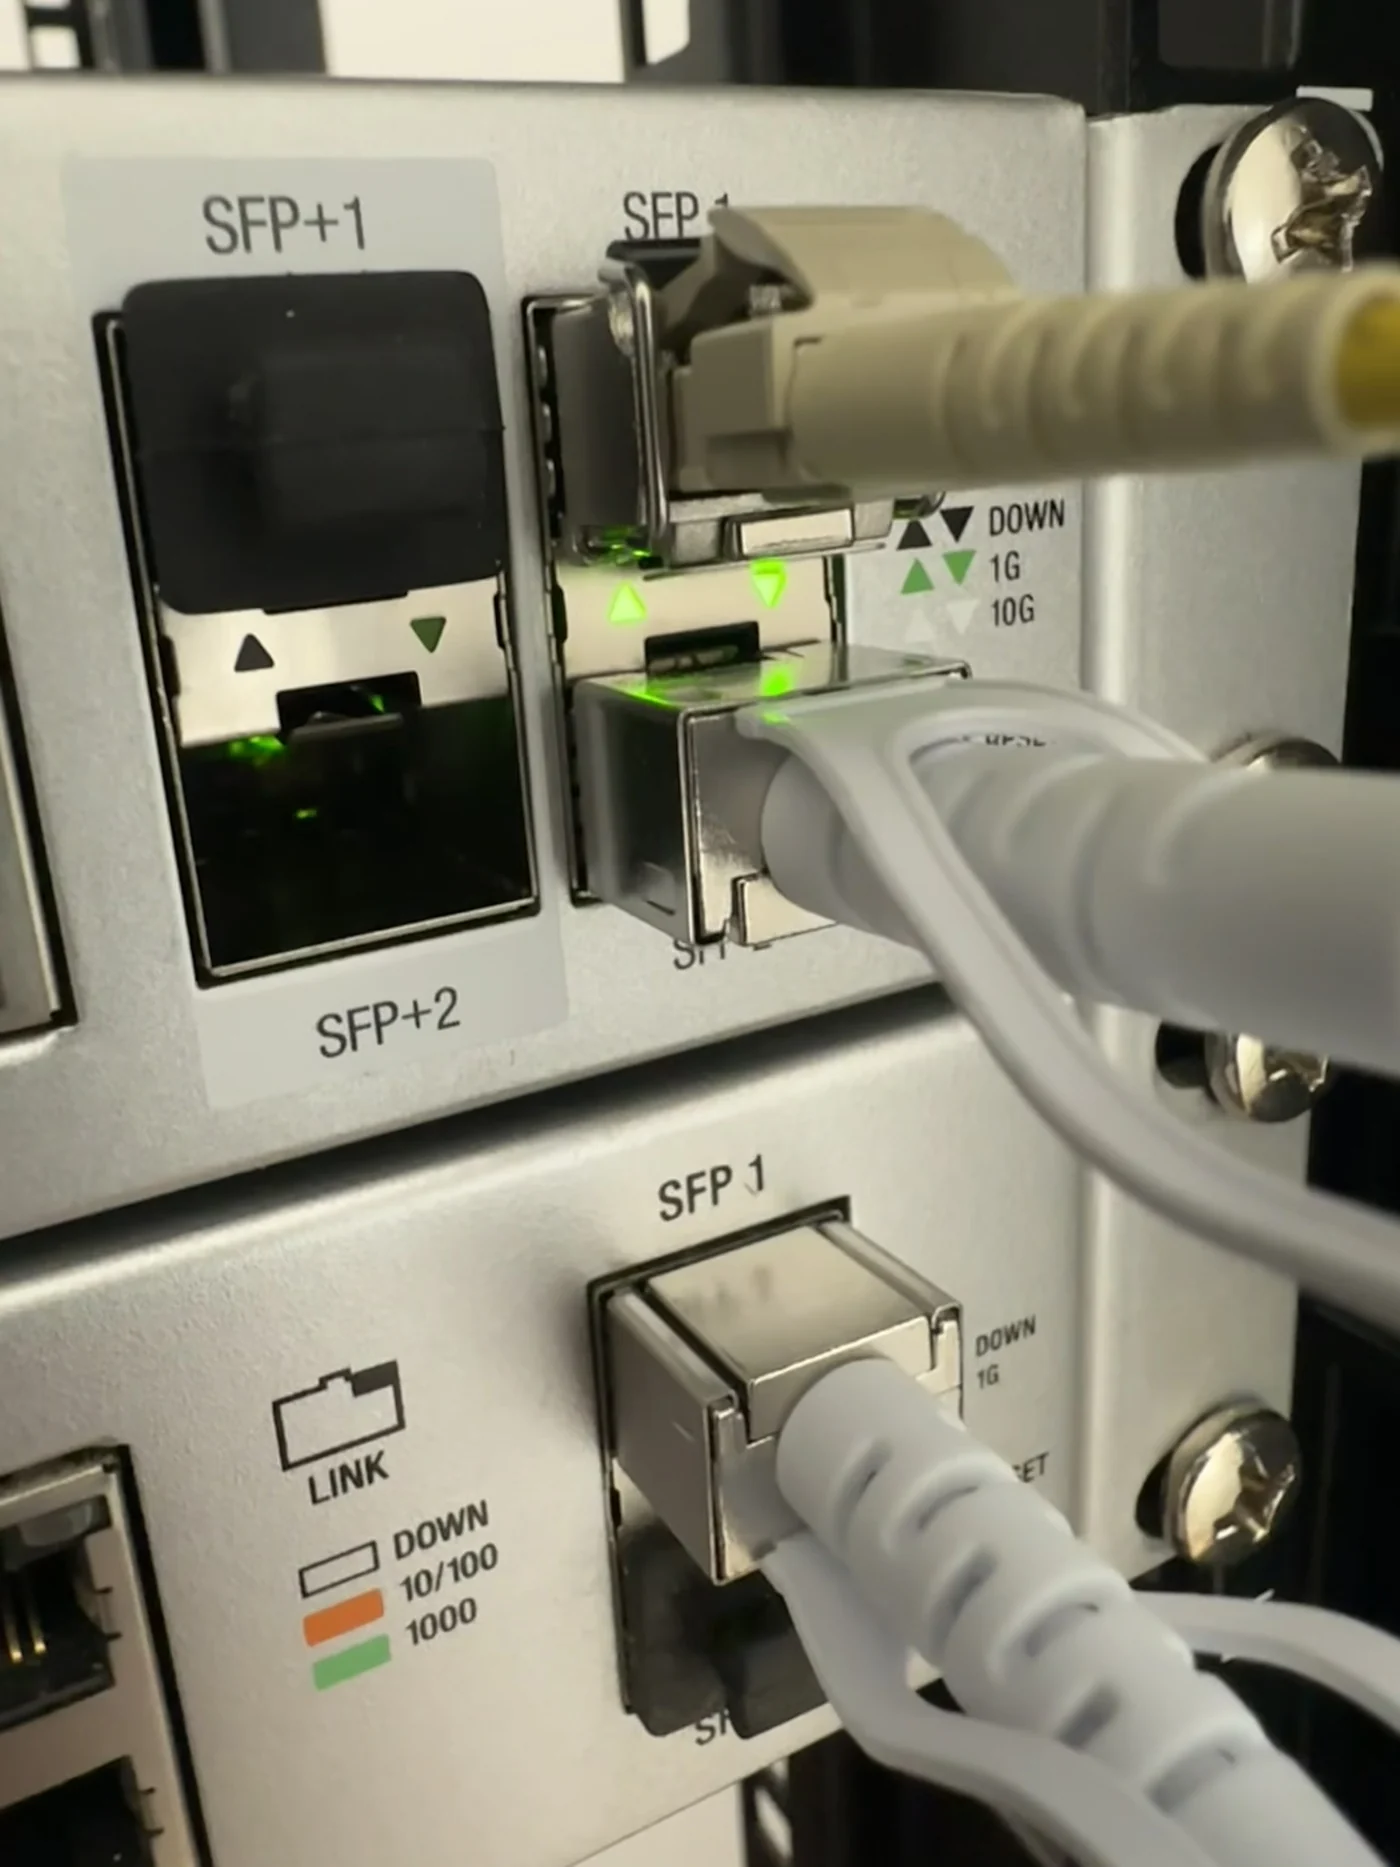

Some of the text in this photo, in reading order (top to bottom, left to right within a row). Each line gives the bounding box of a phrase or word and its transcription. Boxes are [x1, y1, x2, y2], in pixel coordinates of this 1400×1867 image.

[202, 194, 365, 255] SFP+1
[623, 191, 699, 239] SFP
[989, 499, 1065, 536] DOWN
[990, 550, 1021, 582] 1G
[991, 593, 1035, 627] 10G
[316, 986, 461, 1058] SFP+2
[658, 1153, 764, 1221] SFP 1
[976, 1315, 1036, 1357] DOWN
[977, 1364, 999, 1389] 1G
[308, 1450, 389, 1505] LINK
[393, 1500, 488, 1560] DOWN
[400, 1543, 498, 1601] 10/100
[405, 1597, 477, 1645] 1000
